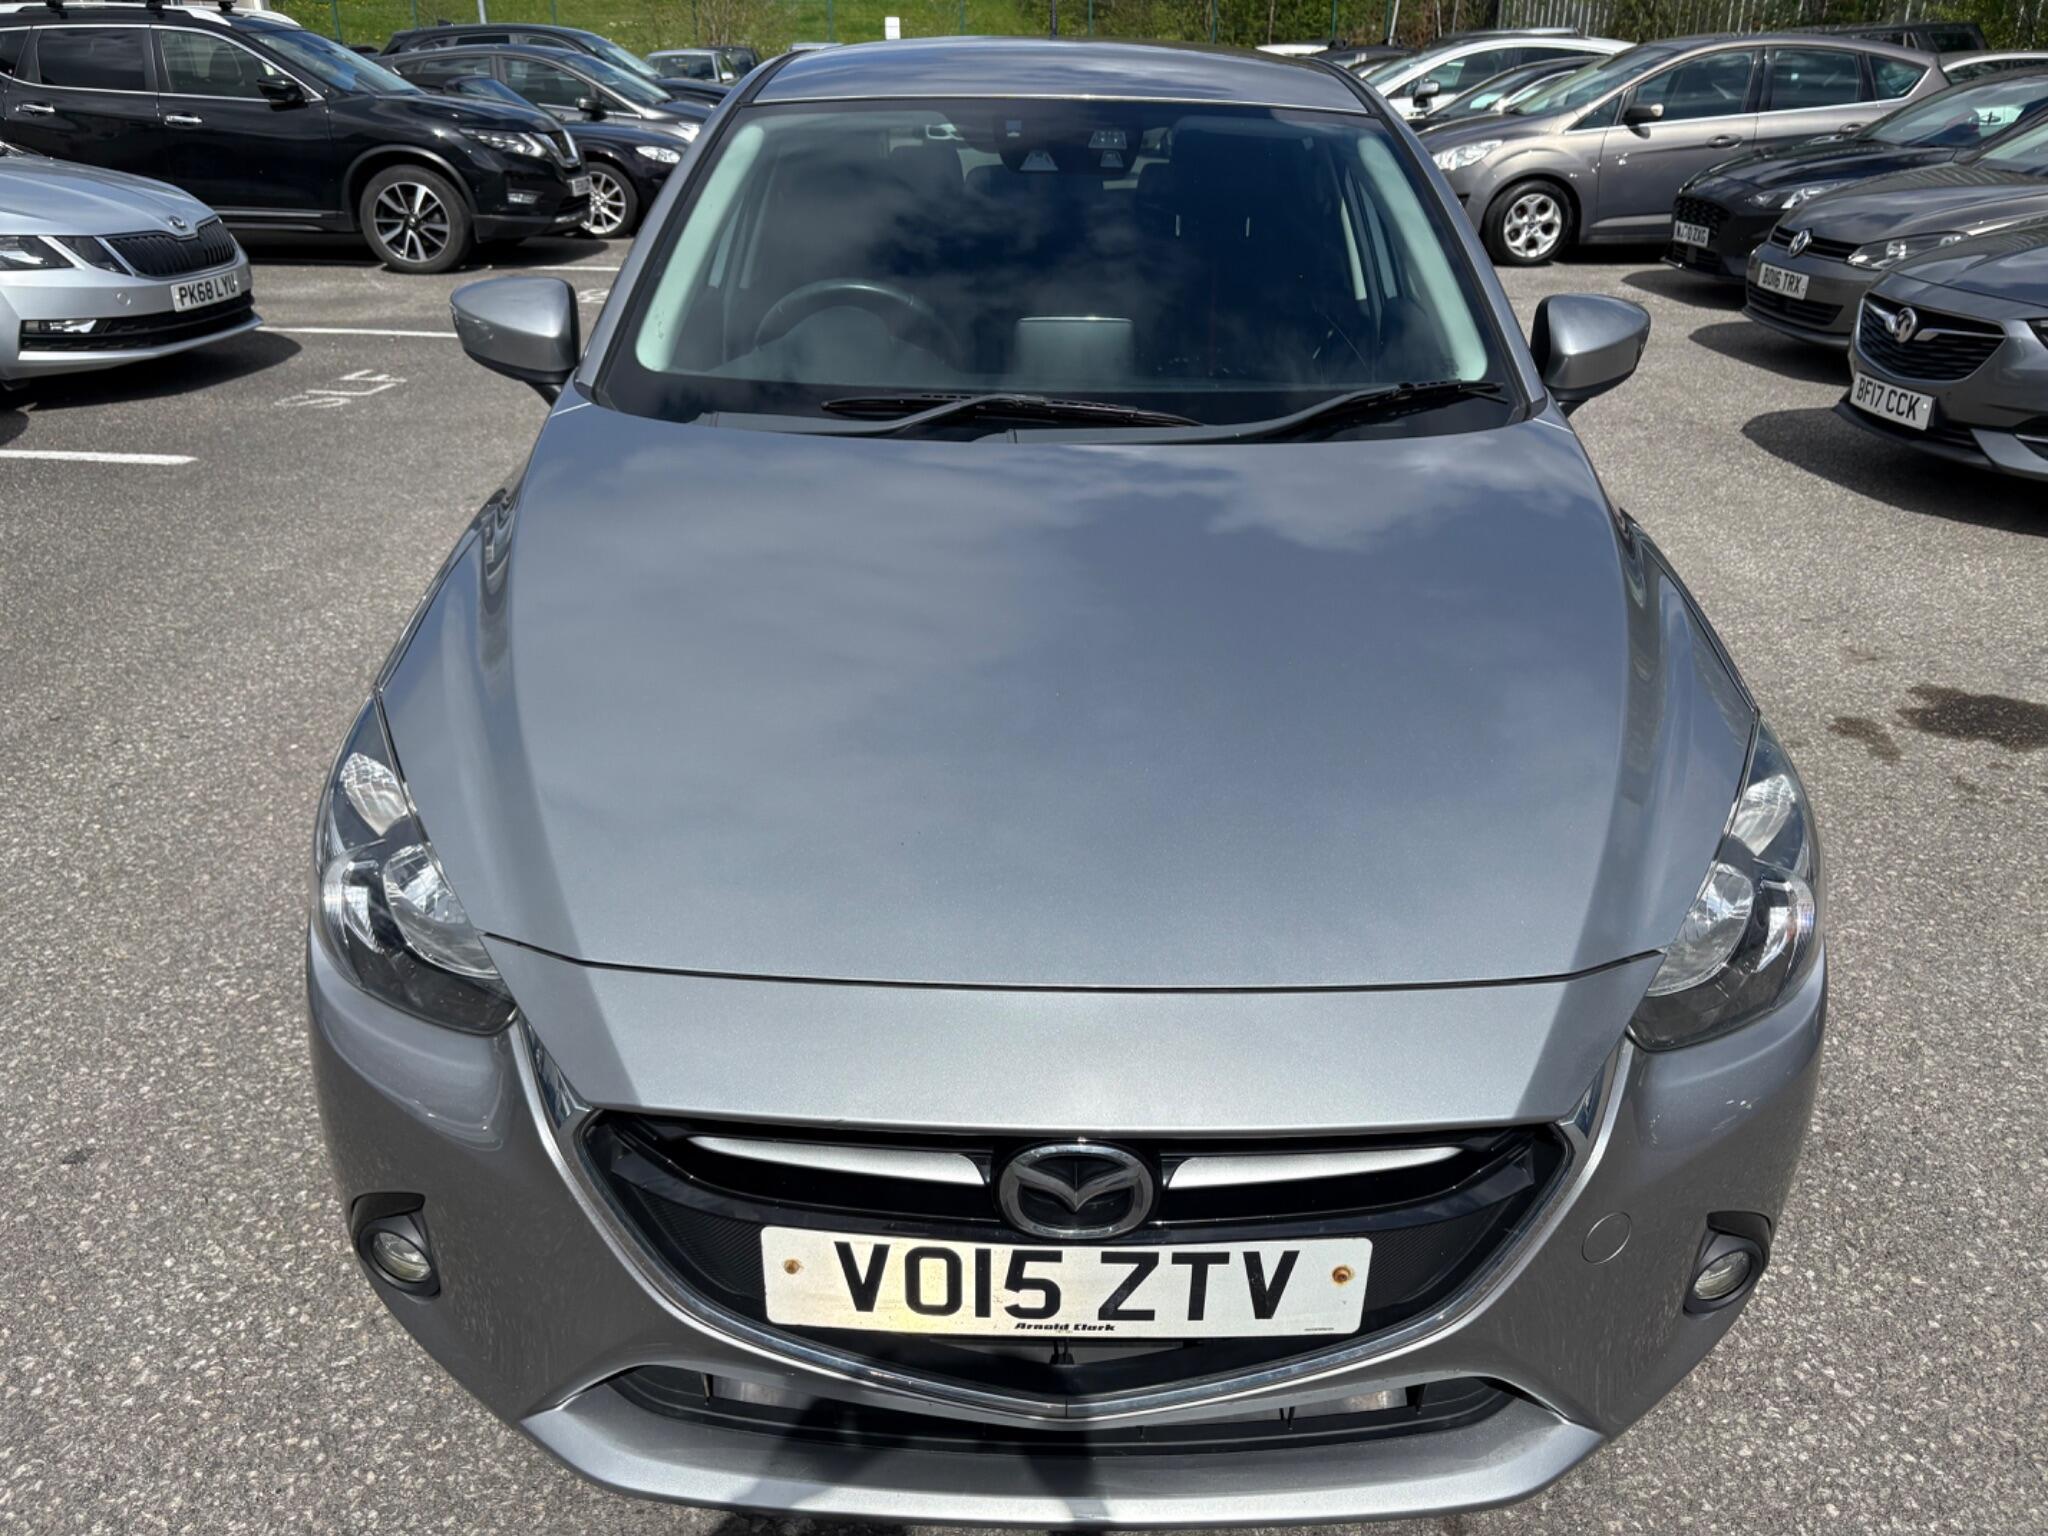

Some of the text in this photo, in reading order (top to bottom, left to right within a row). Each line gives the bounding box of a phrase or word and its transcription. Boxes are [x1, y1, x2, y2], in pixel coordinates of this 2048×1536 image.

[179, 273, 237, 306] PK68 LYU
[1782, 272, 1802, 294] TRX
[1857, 377, 1920, 421] BF17 CCK
[834, 1241, 1301, 1321] VO15 ZTV
[1014, 1322, 1116, 1331] Arnold Clark
